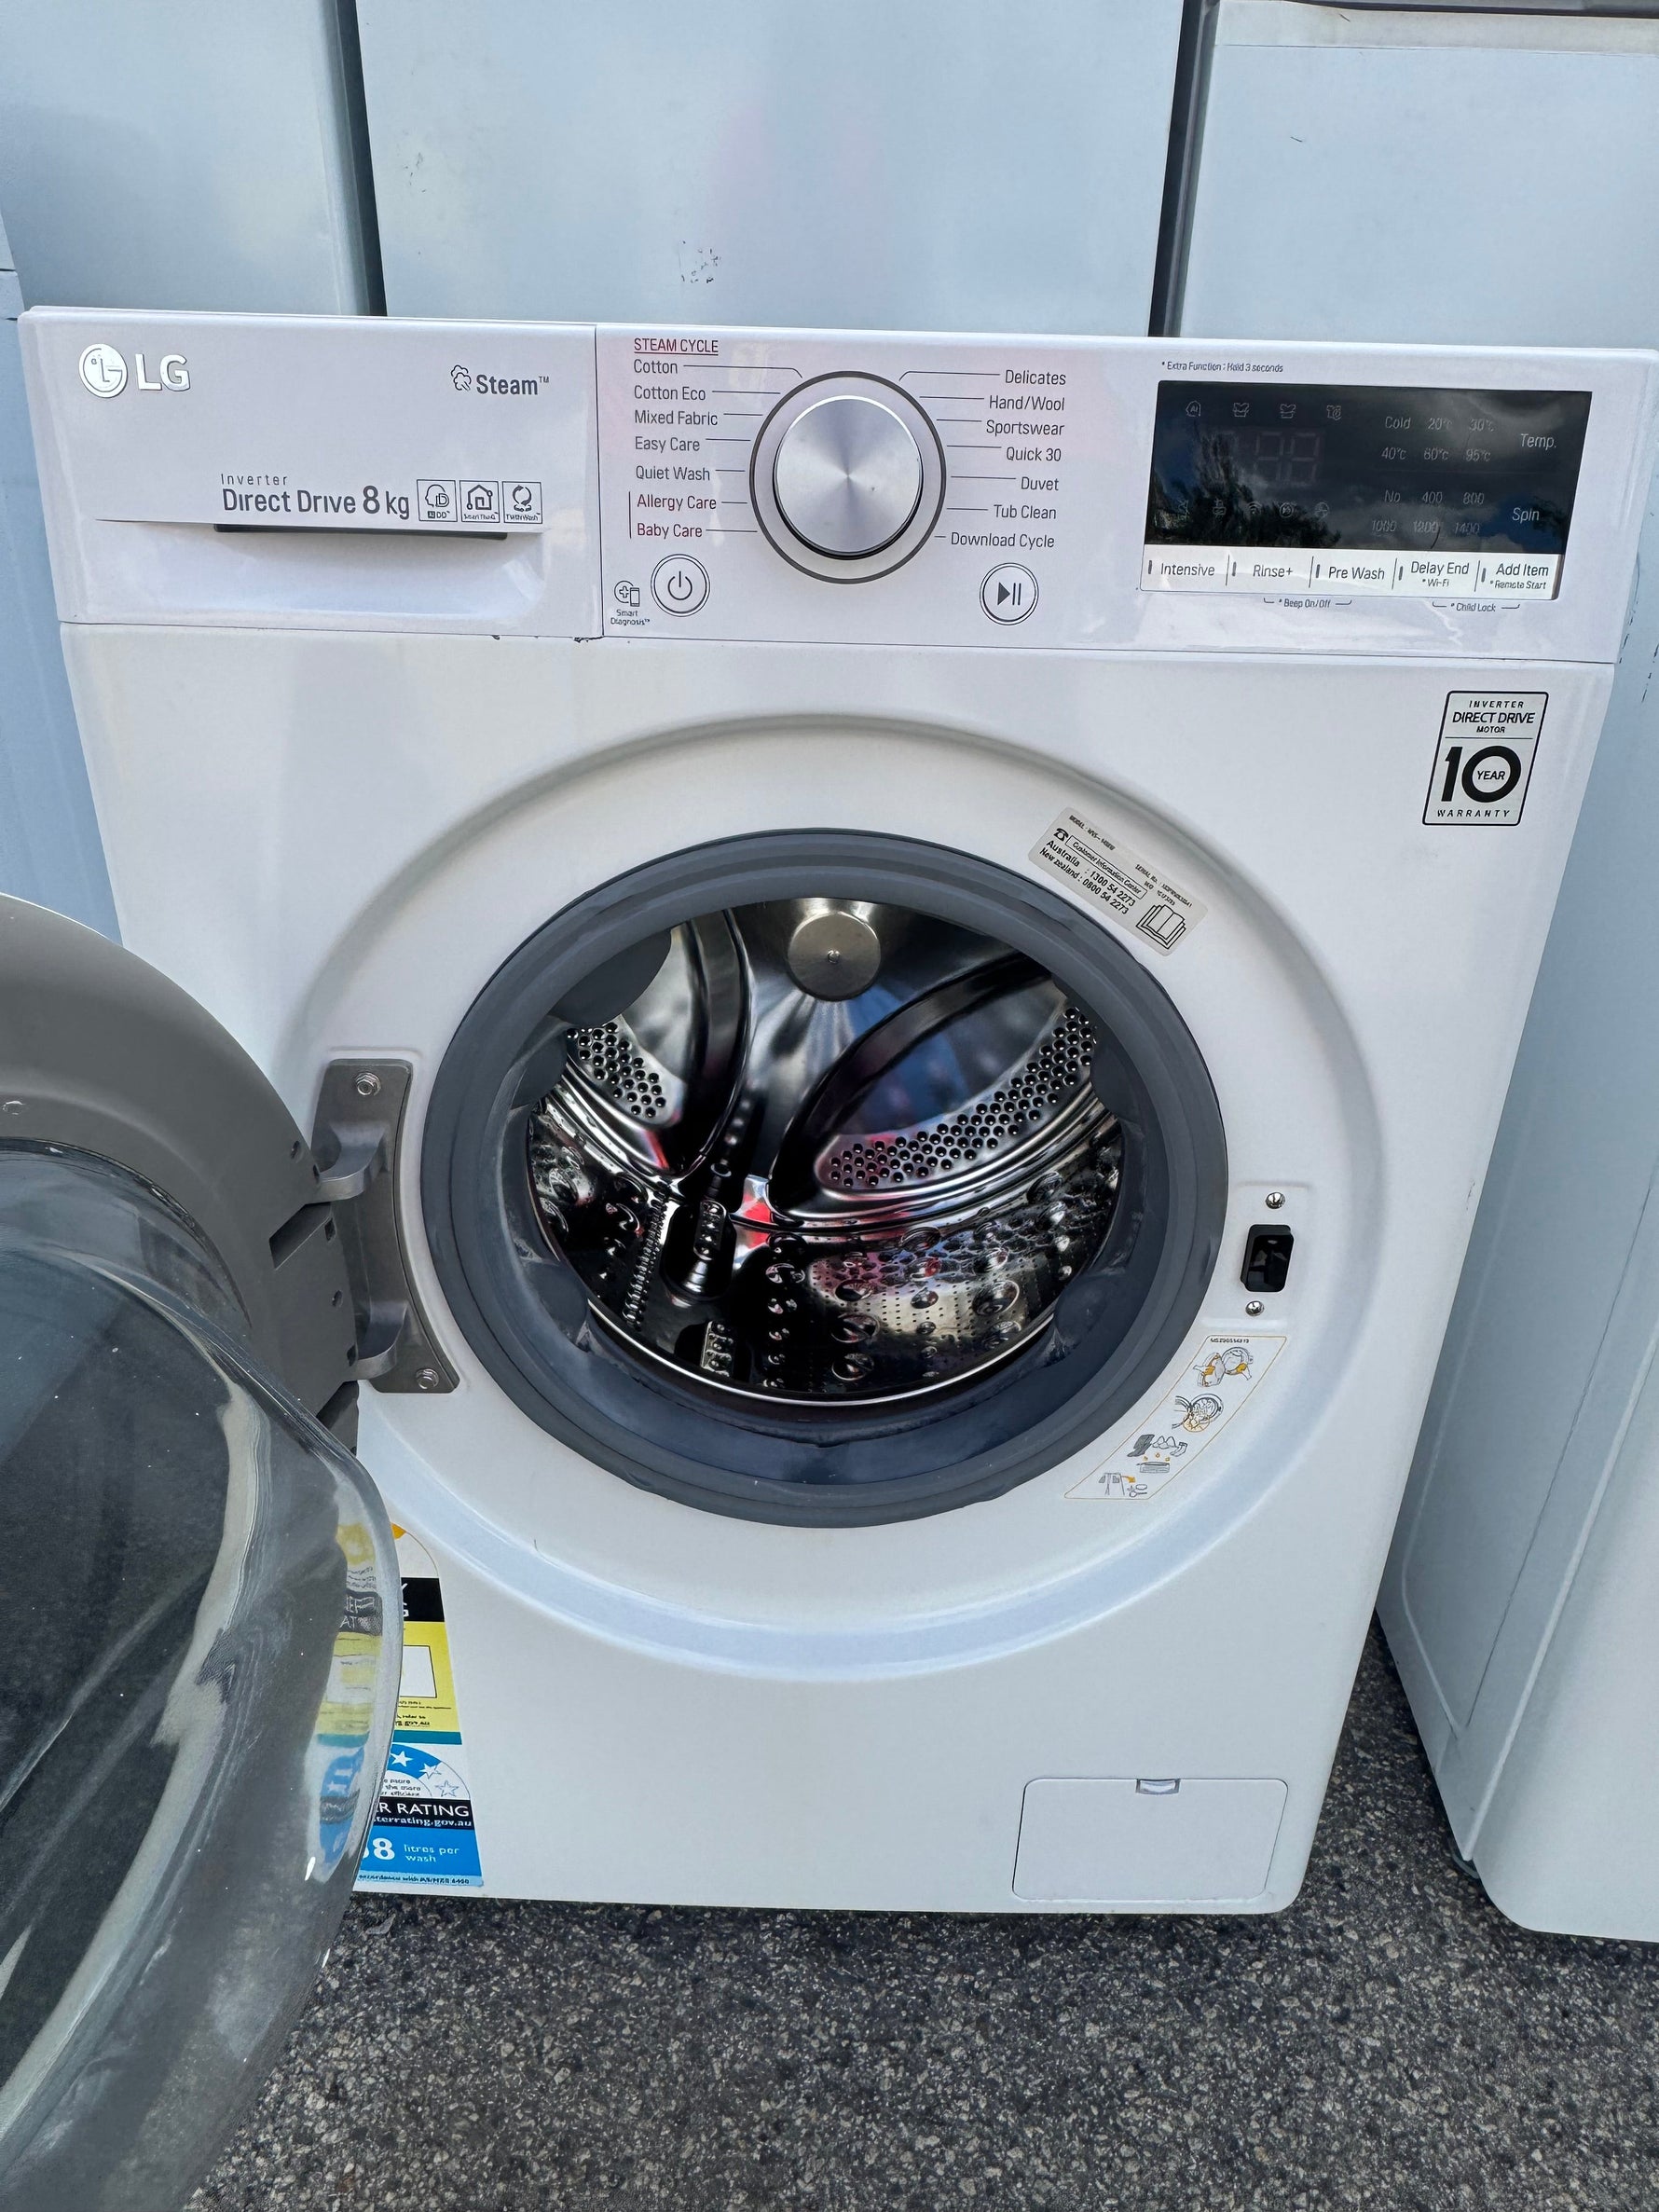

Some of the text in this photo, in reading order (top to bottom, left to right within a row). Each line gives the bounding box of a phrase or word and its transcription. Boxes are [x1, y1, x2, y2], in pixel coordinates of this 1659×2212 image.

[634, 337, 719, 352] STEAM CYCLE
[135, 353, 190, 392] LG
[634, 359, 678, 374] Cotton
[1167, 361, 1187, 370] Extra
[1188, 362, 1221, 371] Function
[1227, 363, 1244, 371] Hold
[1252, 364, 1283, 373] seconds
[1005, 369, 1066, 385] Delicates
[634, 385, 706, 401] Cotton Eco
[989, 394, 1064, 411] Hand/Wool
[635, 410, 718, 426] Mixed Fabric
[1385, 416, 1411, 430] Cold
[986, 419, 1064, 436] Sportswear
[635, 436, 700, 453] Easy Care
[1520, 433, 1556, 451] Temp.
[1007, 447, 1062, 461] Quick 30
[221, 474, 288, 486] Inverter
[636, 465, 710, 481] Quiet Wash
[1021, 476, 1059, 491] Duvet
[223, 486, 410, 520] Direct Drive 8 kg
[637, 494, 717, 512] Allergy Care
[1384, 489, 1485, 504] No 400 800
[994, 504, 1057, 519] Tub Clean
[1512, 507, 1540, 524] Spin
[637, 522, 703, 540] Baby Care
[1413, 520, 1440, 533] 1200
[951, 531, 1055, 551] Download Cycle
[1160, 563, 1214, 576] Intensive
[1253, 564, 1293, 578] Rinse+
[1328, 566, 1385, 580] Pre Wash
[1410, 560, 1470, 576] Delay End
[1495, 563, 1549, 577] Add Item
[1494, 580, 1546, 590] Remote Start
[1283, 598, 1331, 609] Beep On/Off
[1456, 602, 1496, 612] Child Lock
[1469, 700, 1524, 708] INVERTER
[1452, 711, 1536, 723] DIRECT DRIVE
[1476, 725, 1505, 734] MOTOR
[1441, 745, 1522, 803] 10
[1477, 771, 1506, 780] YEAR
[1437, 809, 1510, 817] WARRANTY
[1039, 847, 1055, 861] New
[1082, 878, 1102, 895] 0800
[1100, 892, 1111, 901] 54
[1109, 899, 1130, 914] 2273
[1046, 840, 1080, 867] Australia
[1090, 871, 1108, 886] 1300
[1107, 884, 1118, 894] 54
[1117, 890, 1136, 907] 2273
[397, 1803, 469, 1817] RATING
[373, 1816, 472, 1827] terrating.gov.au
[404, 1844, 434, 1853] litres
[439, 1847, 459, 1856] per
[405, 1854, 436, 1862] wash
